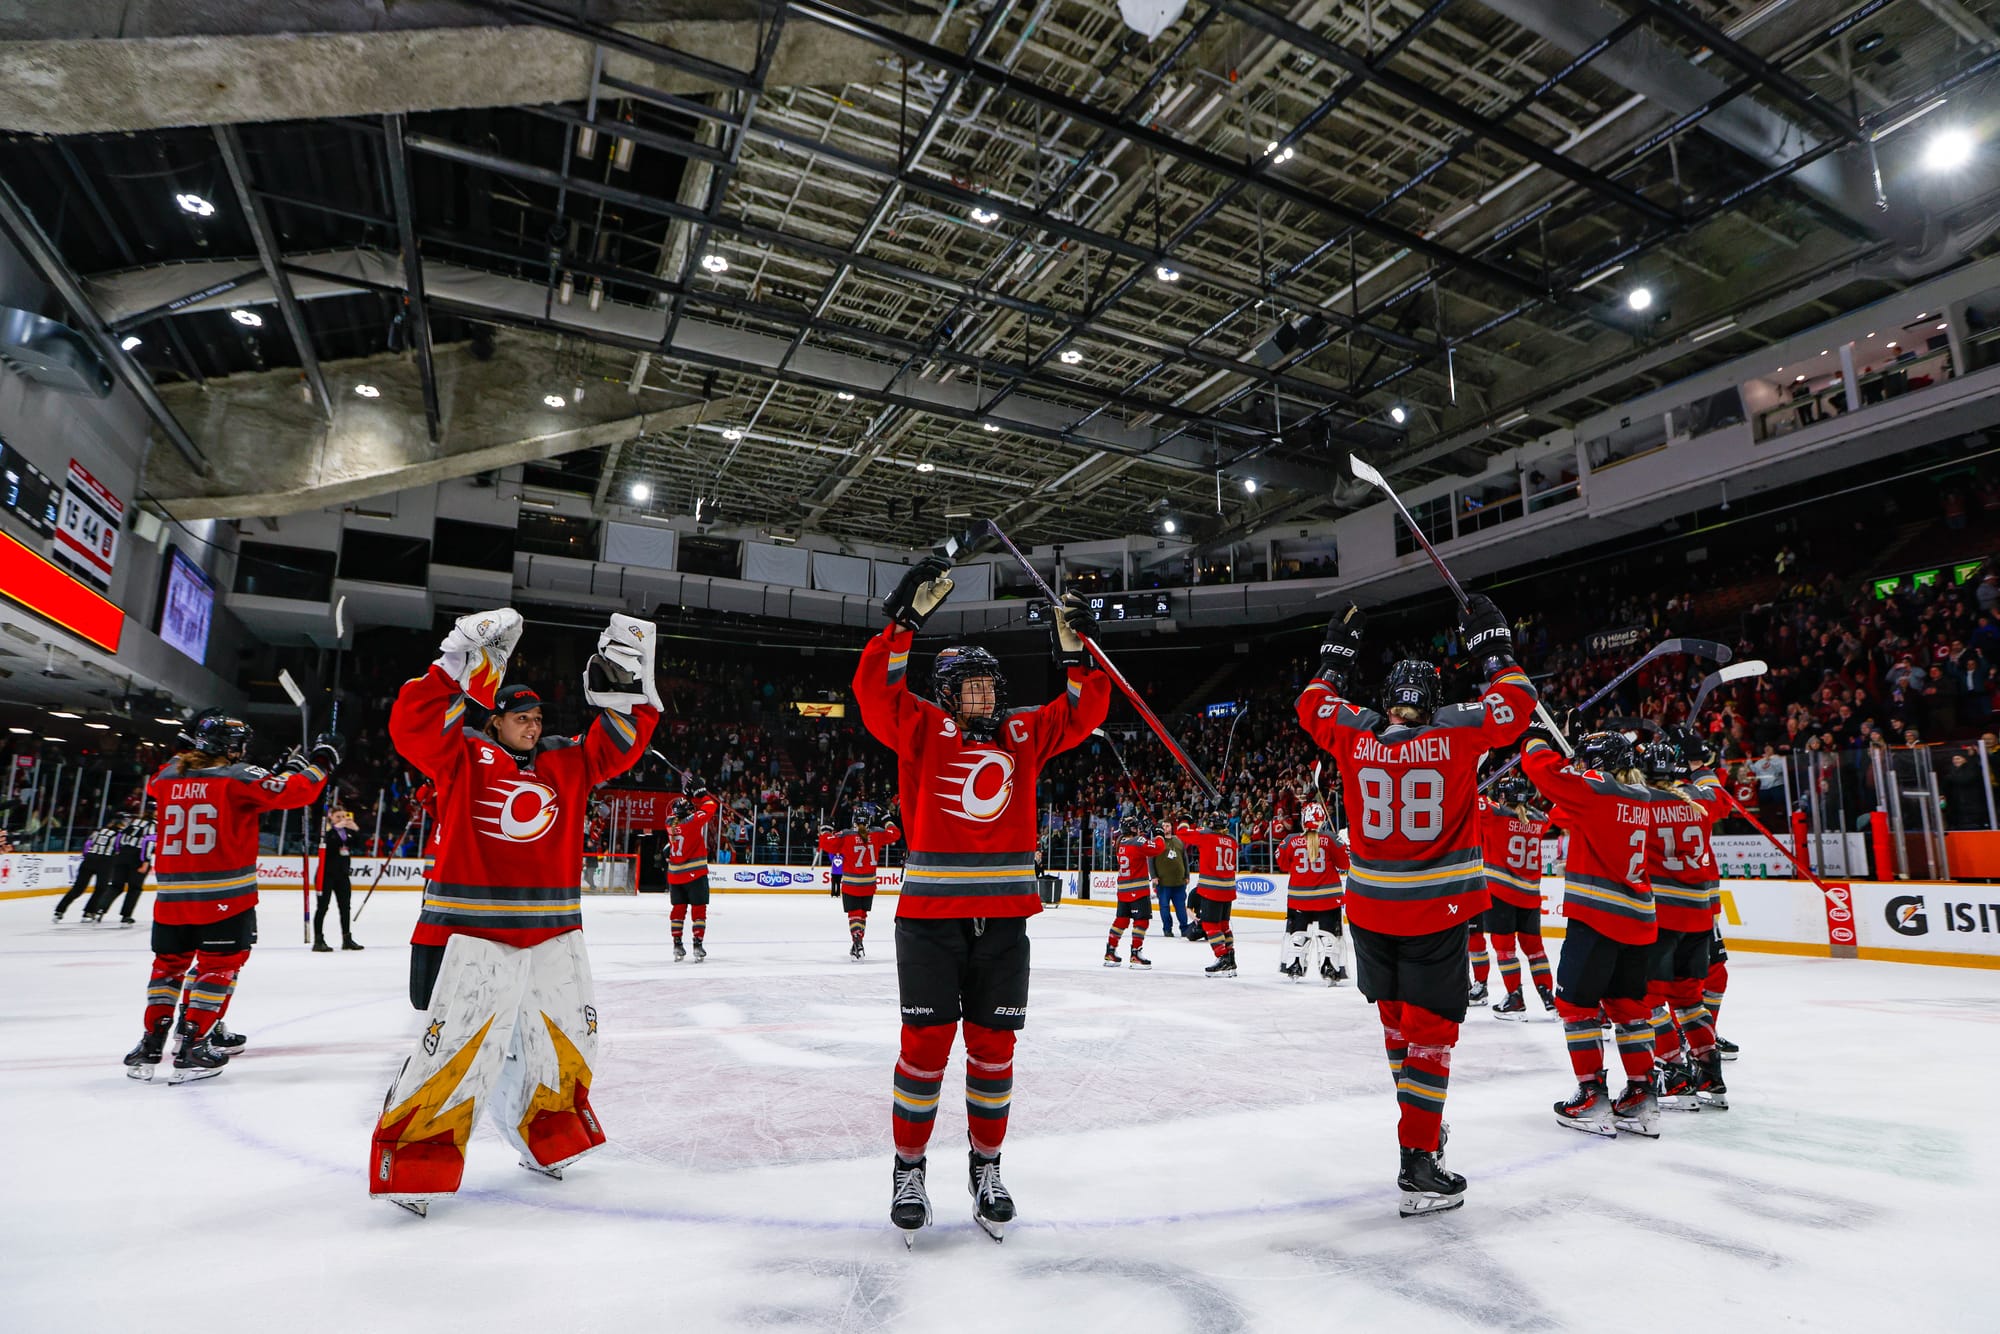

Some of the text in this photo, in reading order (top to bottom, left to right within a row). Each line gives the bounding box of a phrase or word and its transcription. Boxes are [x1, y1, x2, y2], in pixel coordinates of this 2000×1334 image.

[65, 499, 80, 531] 15
[82, 515, 99, 546] 44
[1402, 691, 1418, 703] 88
[1008, 719, 1029, 743] C
[1354, 736, 1451, 764] SAVOLAINEN
[171, 783, 209, 801] CLARK
[1357, 767, 1444, 842] 88
[162, 804, 217, 855] 26
[854, 844, 877, 868] 71
[1215, 846, 1235, 871] 10
[1294, 848, 1326, 874] 38
[1506, 835, 1541, 871] 92
[349, 863, 422, 880] ark NINJA
[759, 873, 791, 887] Royale
[1237, 881, 1270, 892] SWORD
[917, 1006, 934, 1016] NINJA
[994, 1006, 1026, 1015] BAUE
